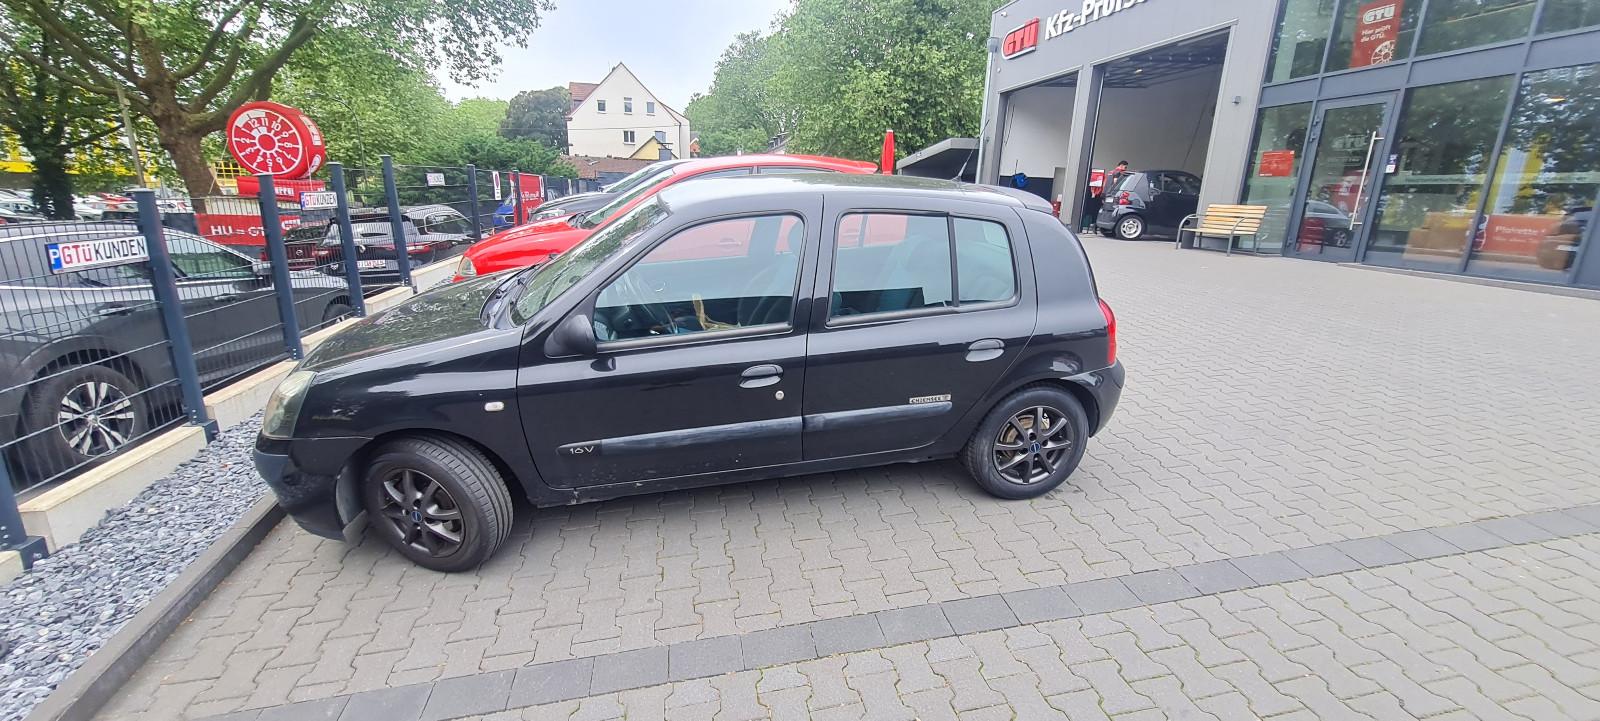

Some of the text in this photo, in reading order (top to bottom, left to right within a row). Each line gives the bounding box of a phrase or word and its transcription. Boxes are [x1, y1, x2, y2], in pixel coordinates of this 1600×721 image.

[1003, 17, 1039, 56] GTÜ
[248, 117, 281, 131] 12 11 10
[210, 225, 232, 237] HU
[50, 249, 60, 265] P
[569, 445, 594, 454] 16V
